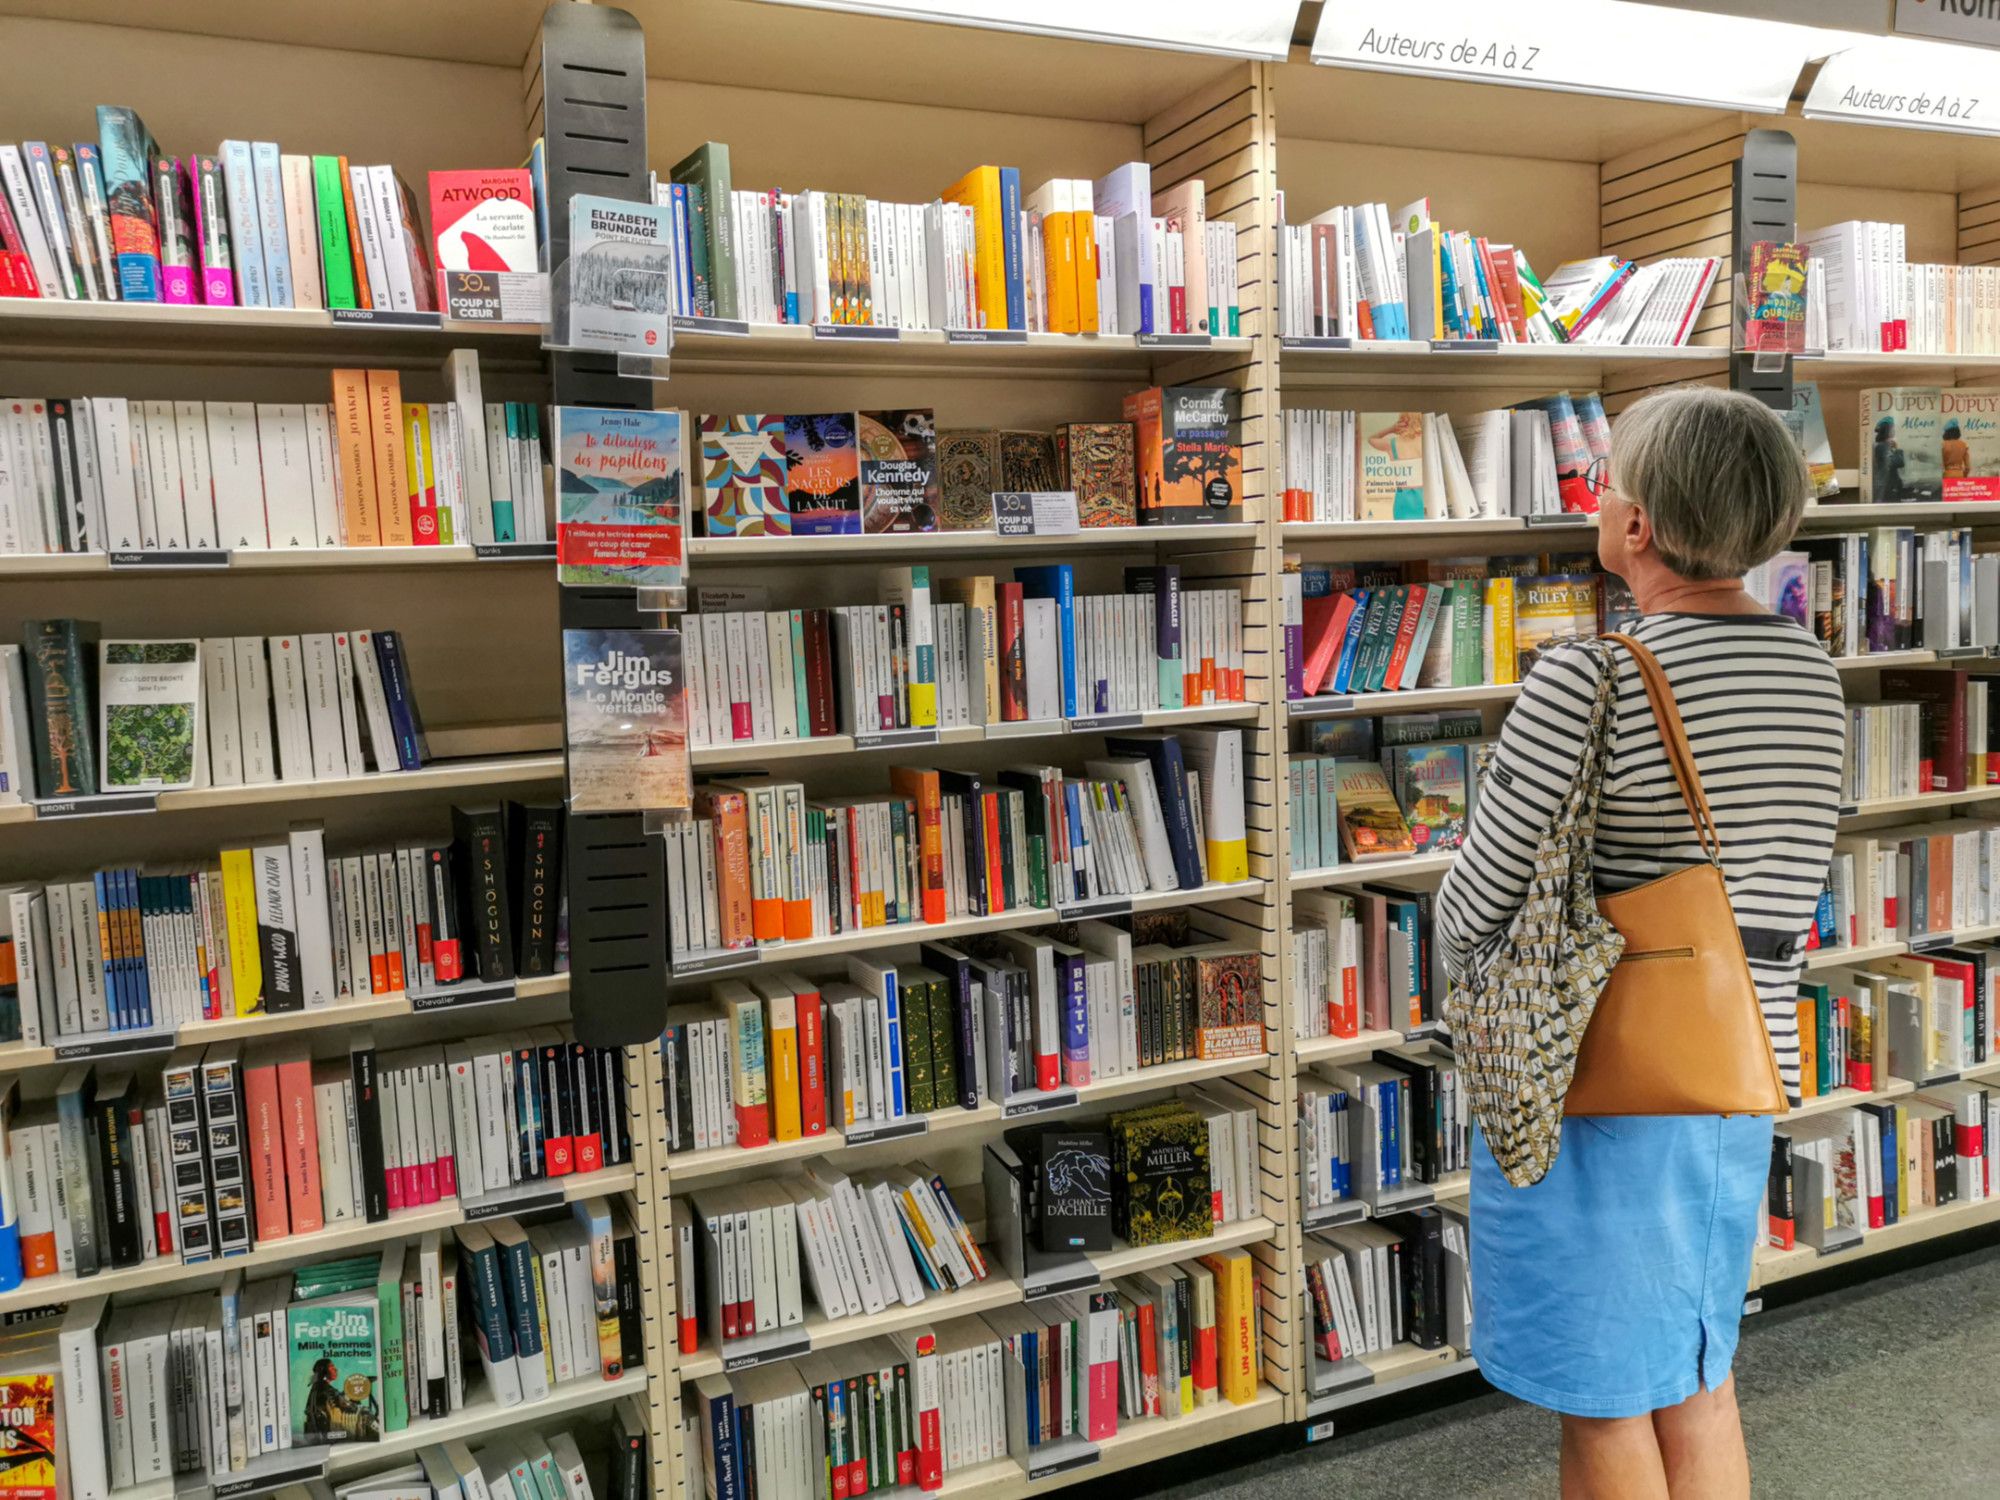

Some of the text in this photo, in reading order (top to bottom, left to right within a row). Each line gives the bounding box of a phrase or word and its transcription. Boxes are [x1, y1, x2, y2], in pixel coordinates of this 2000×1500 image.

[1358, 28, 1540, 71] Auteurs de A à Z
[1839, 85, 1979, 119] Auteurs de A à Z
[481, 176, 520, 185] MARGARET
[441, 187, 522, 202] ATWOOD
[476, 212, 525, 221] La servante
[591, 208, 658, 227] ELIZABETH
[492, 222, 525, 232] écarlate
[591, 220, 658, 238] BRUNDAGE
[595, 232, 619, 242] POINT
[458, 273, 484, 292] 30
[451, 297, 500, 308] COUP DE
[336, 310, 374, 319] ATWOOD
[459, 308, 494, 319] CŒUR
[347, 385, 358, 421] BAKER
[381, 385, 392, 421] BAKER
[1180, 397, 1224, 409] Cormac
[1877, 392, 1937, 412] DUPUY
[1940, 393, 2000, 413] DUPUY
[601, 416, 642, 428] Jenny Hale
[1174, 409, 1229, 425] McCarthy
[1902, 417, 1936, 428] Albane
[1964, 418, 1997, 430] Albane
[1176, 429, 1229, 439] Le passager
[585, 433, 657, 450] La délicatesse
[1176, 443, 1230, 452] Stella Maris
[574, 451, 668, 473] des papillons
[880, 461, 917, 472] Douglas
[1365, 455, 1387, 466] JODI
[809, 467, 832, 478] LES
[867, 467, 930, 485] Kennedy
[1365, 465, 1414, 477] PICOULT
[791, 477, 851, 489] NAGEURS
[875, 487, 925, 497] L'homme qui
[816, 499, 848, 511] NUIT
[877, 496, 924, 504] voulait vivre
[899, 504, 912, 513] vie
[998, 516, 1033, 525] COUP DE
[1003, 525, 1029, 534] CŒUR
[478, 546, 501, 554] Banks
[600, 541, 619, 549] coup
[114, 553, 144, 562] Auster
[702, 591, 746, 600] Elizabeth Jane
[1528, 591, 1569, 603] RILEY
[1170, 577, 1179, 628] LES ORACLES
[1458, 594, 1468, 629] RILEY
[1500, 592, 1510, 629] RILEY
[1350, 602, 1365, 638] RILEY
[1369, 603, 1387, 635] RILEY
[1386, 600, 1404, 635] RILEY
[1403, 602, 1422, 635] RILEY
[598, 651, 651, 672] Jim
[577, 664, 673, 690] Fergus
[586, 689, 665, 701] Le Monde
[596, 701, 667, 715] véritable
[1073, 719, 1098, 729] Kennedy
[1399, 730, 1434, 742] RILEY
[1444, 725, 1478, 738] RILEY
[1416, 765, 1458, 780] RILEY
[1342, 775, 1387, 791] RILEY
[269, 888, 284, 924] ELEANOR
[1063, 907, 1083, 916] London
[271, 933, 287, 961] WOOD
[677, 960, 705, 971] Kerouac
[417, 996, 456, 1008] Chevalier
[1073, 967, 1086, 1035] BETTY
[1205, 1035, 1262, 1049] BLACKWATER
[59, 1046, 91, 1056] Capote
[1008, 1104, 1038, 1115] Mc Carthy
[848, 1131, 874, 1141] Maynard
[1152, 1146, 1185, 1156] MADELINE
[1147, 1151, 1192, 1167] MILLER
[1057, 1198, 1096, 1207] LE CHANT
[470, 1206, 499, 1217] Dickens
[1047, 1204, 1108, 1217] D'ACHILLE
[483, 1253, 493, 1282] FORTUNE
[516, 1249, 524, 1277] FORTUNE
[327, 1311, 368, 1327] Jim
[294, 1322, 370, 1340] Fergus
[298, 1340, 372, 1351] Mille femmes
[1239, 1316, 1250, 1376] UN JOUR
[323, 1349, 372, 1358] blanches
[728, 1356, 759, 1368] McKinley
[1031, 1466, 1057, 1478] Morrison
[217, 1481, 254, 1495] Faulkner
